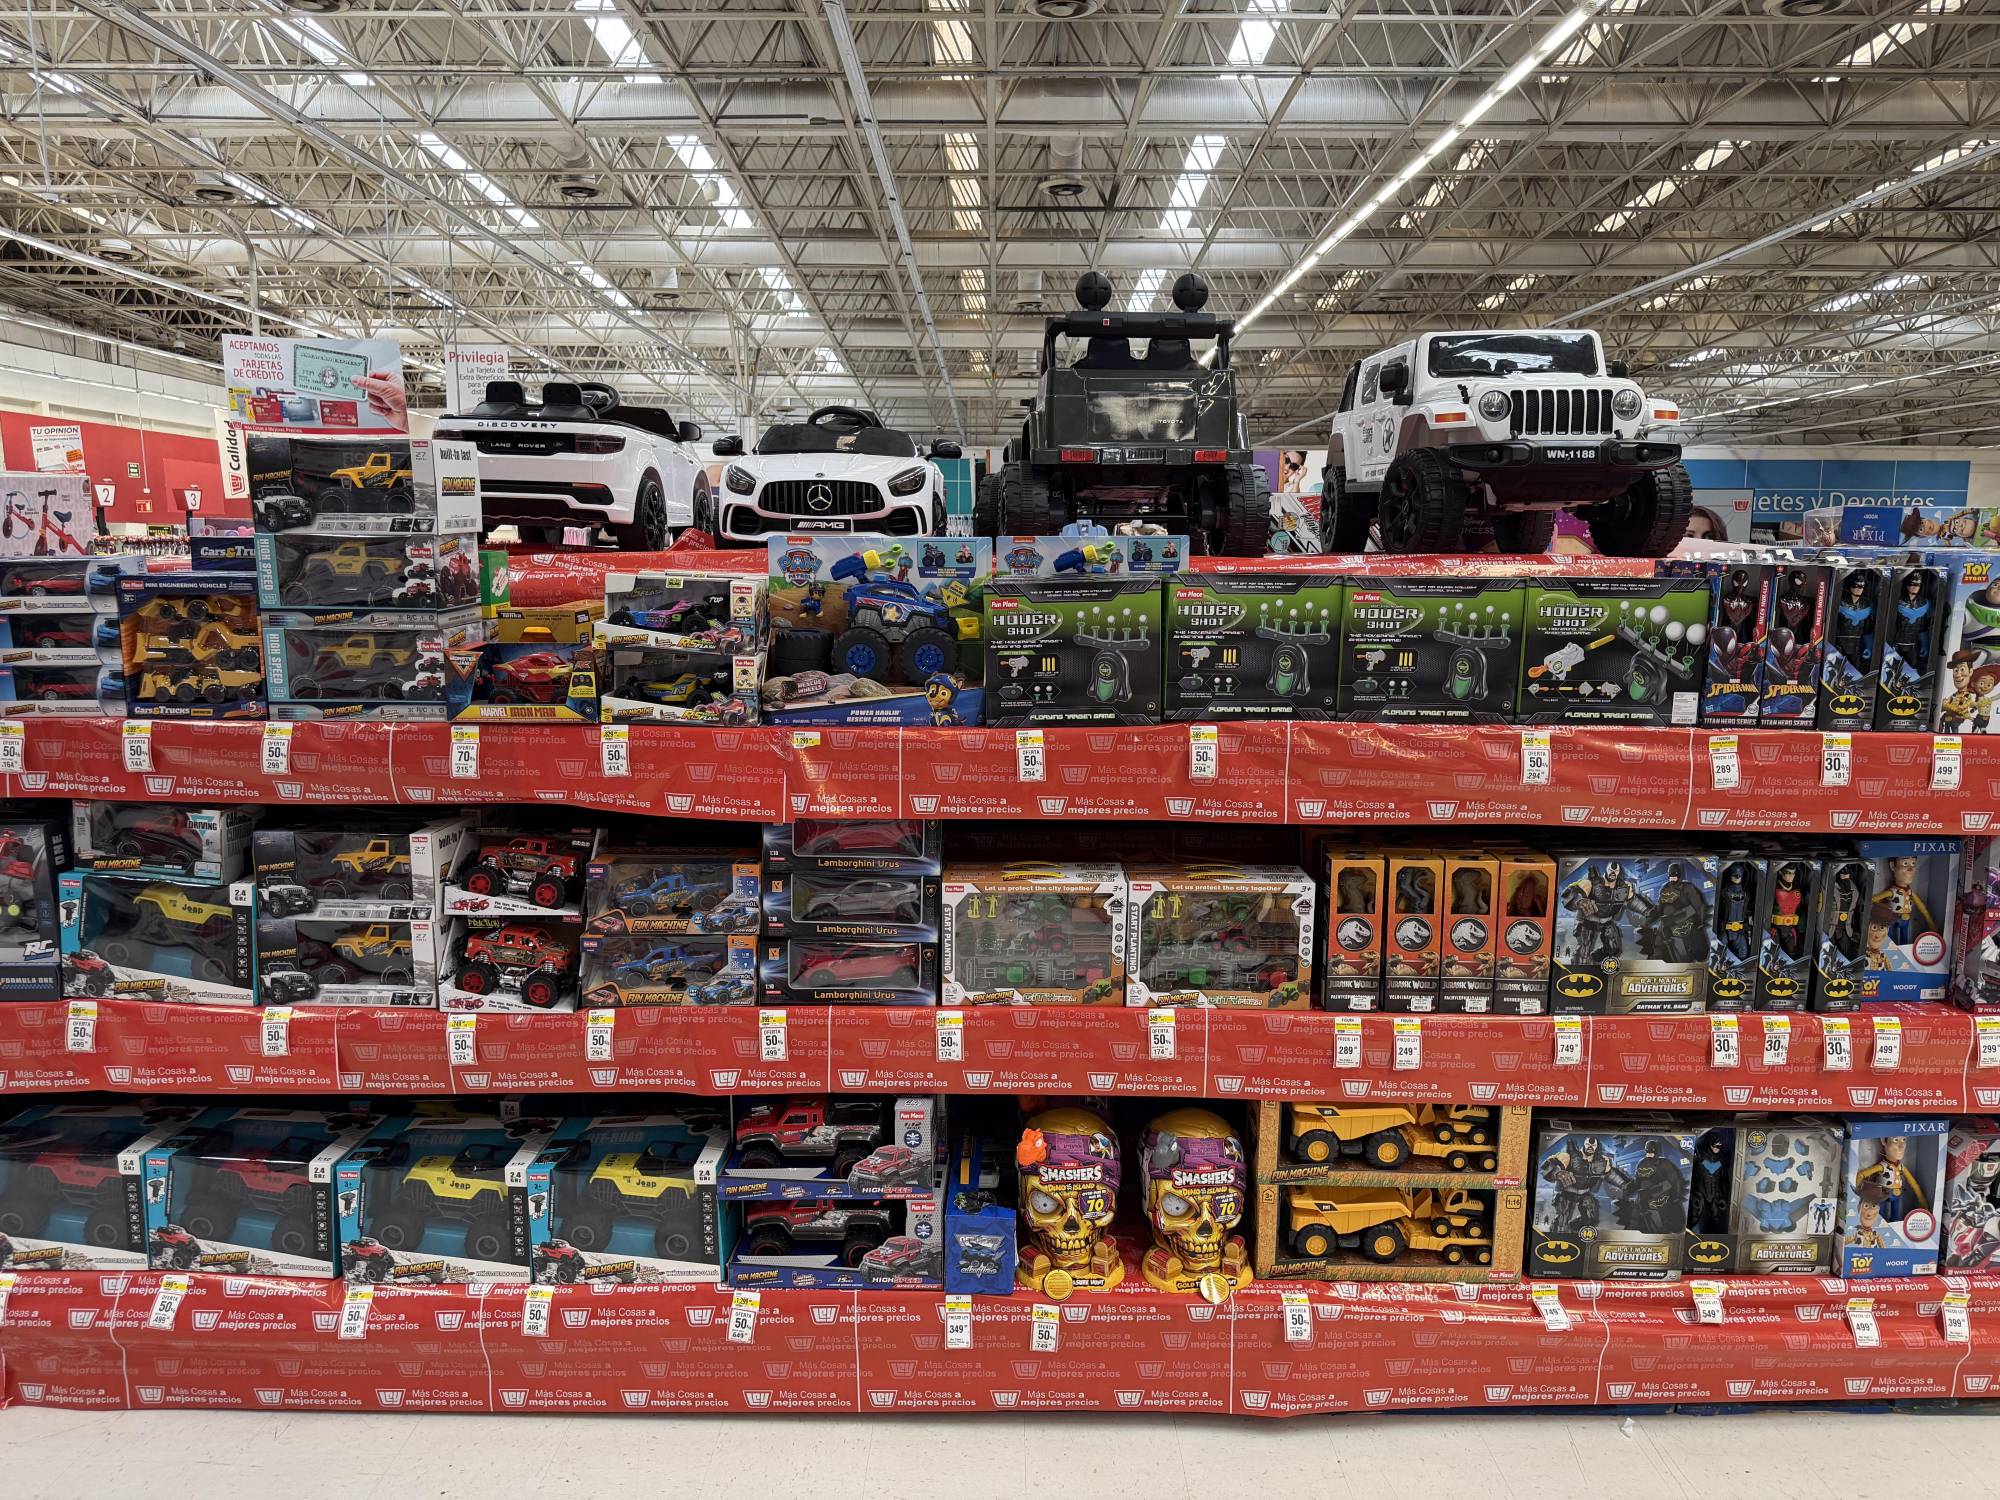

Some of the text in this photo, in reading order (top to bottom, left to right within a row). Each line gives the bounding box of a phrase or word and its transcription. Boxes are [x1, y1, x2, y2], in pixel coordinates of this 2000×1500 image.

[230, 340, 279, 352] ACEPTAMOS
[449, 351, 504, 365] Privilegia
[241, 359, 282, 370] TARJETAS
[233, 367, 284, 381] DE CRÉDITO
[476, 367, 496, 375] Tarjeta
[228, 420, 241, 471] Calidad
[253, 470, 291, 481] FUN MACHINE
[103, 488, 110, 502] 2
[191, 494, 196, 506] 3
[1753, 495, 1804, 511] etes
[1830, 492, 1934, 507] Deportes
[812, 521, 844, 529] AMG
[1853, 529, 1885, 541] PIXAR
[259, 538, 273, 591] HIGH SPEED
[1963, 562, 1992, 578] TOY
[1760, 580, 1769, 608] MORALES
[1177, 604, 1240, 616] HOVER
[1540, 606, 1603, 618] HOVER
[314, 612, 353, 624] FUN MACHINE
[993, 612, 1056, 626] HOVER
[1191, 617, 1224, 626] SHOT
[1553, 619, 1587, 627] SHOT
[1367, 621, 1401, 629] SHOT
[269, 633, 283, 684] HIGH SPEED
[1708, 682, 1759, 698] SPIDER-MAN
[134, 706, 190, 714] Cars&Trucks
[480, 707, 556, 717] MARVEL IRON MAN
[184, 776, 199, 785] Más
[202, 777, 234, 787] Cosas
[176, 787, 259, 797] mejores precios
[947, 796, 967, 804] Más
[969, 796, 997, 804] Cosas
[940, 805, 1022, 814] mejores precios
[1869, 810, 1929, 820] Más Cosas a
[187, 821, 217, 830] DRIVING
[1858, 820, 1943, 830] mejores precios
[1913, 842, 1956, 851] PIXAR
[93, 859, 141, 869] FUN MACHINE
[818, 858, 900, 869] Lamborghini Urus
[1011, 885, 1038, 893] protect
[1054, 885, 1066, 893] city
[1068, 885, 1092, 893] together
[632, 919, 688, 931] FUN MACHINE
[943, 908, 952, 971] START PLANTING
[1628, 983, 1687, 993] ADVENTURES
[814, 991, 896, 999] Lamborghini Urus
[1000, 1071, 1019, 1080] Más
[1021, 1071, 1049, 1080] Cosas
[993, 1080, 1072, 1089] mejores precios
[1904, 1123, 1946, 1132] PIXAR
[1039, 1166, 1102, 1182] SMASHERS
[1173, 1169, 1235, 1185] SMASHERS
[1271, 1166, 1329, 1180] FUN MACHINE
[726, 1183, 767, 1194] FUN MACHINE
[1087, 1199, 1104, 1211] 70
[1220, 1202, 1235, 1214] 70
[1604, 1252, 1662, 1261] ADVENTURES
[1851, 1256, 1873, 1268] TOY
[1642, 1382, 1659, 1390] Más
[1634, 1389, 1711, 1398] mejores precios
